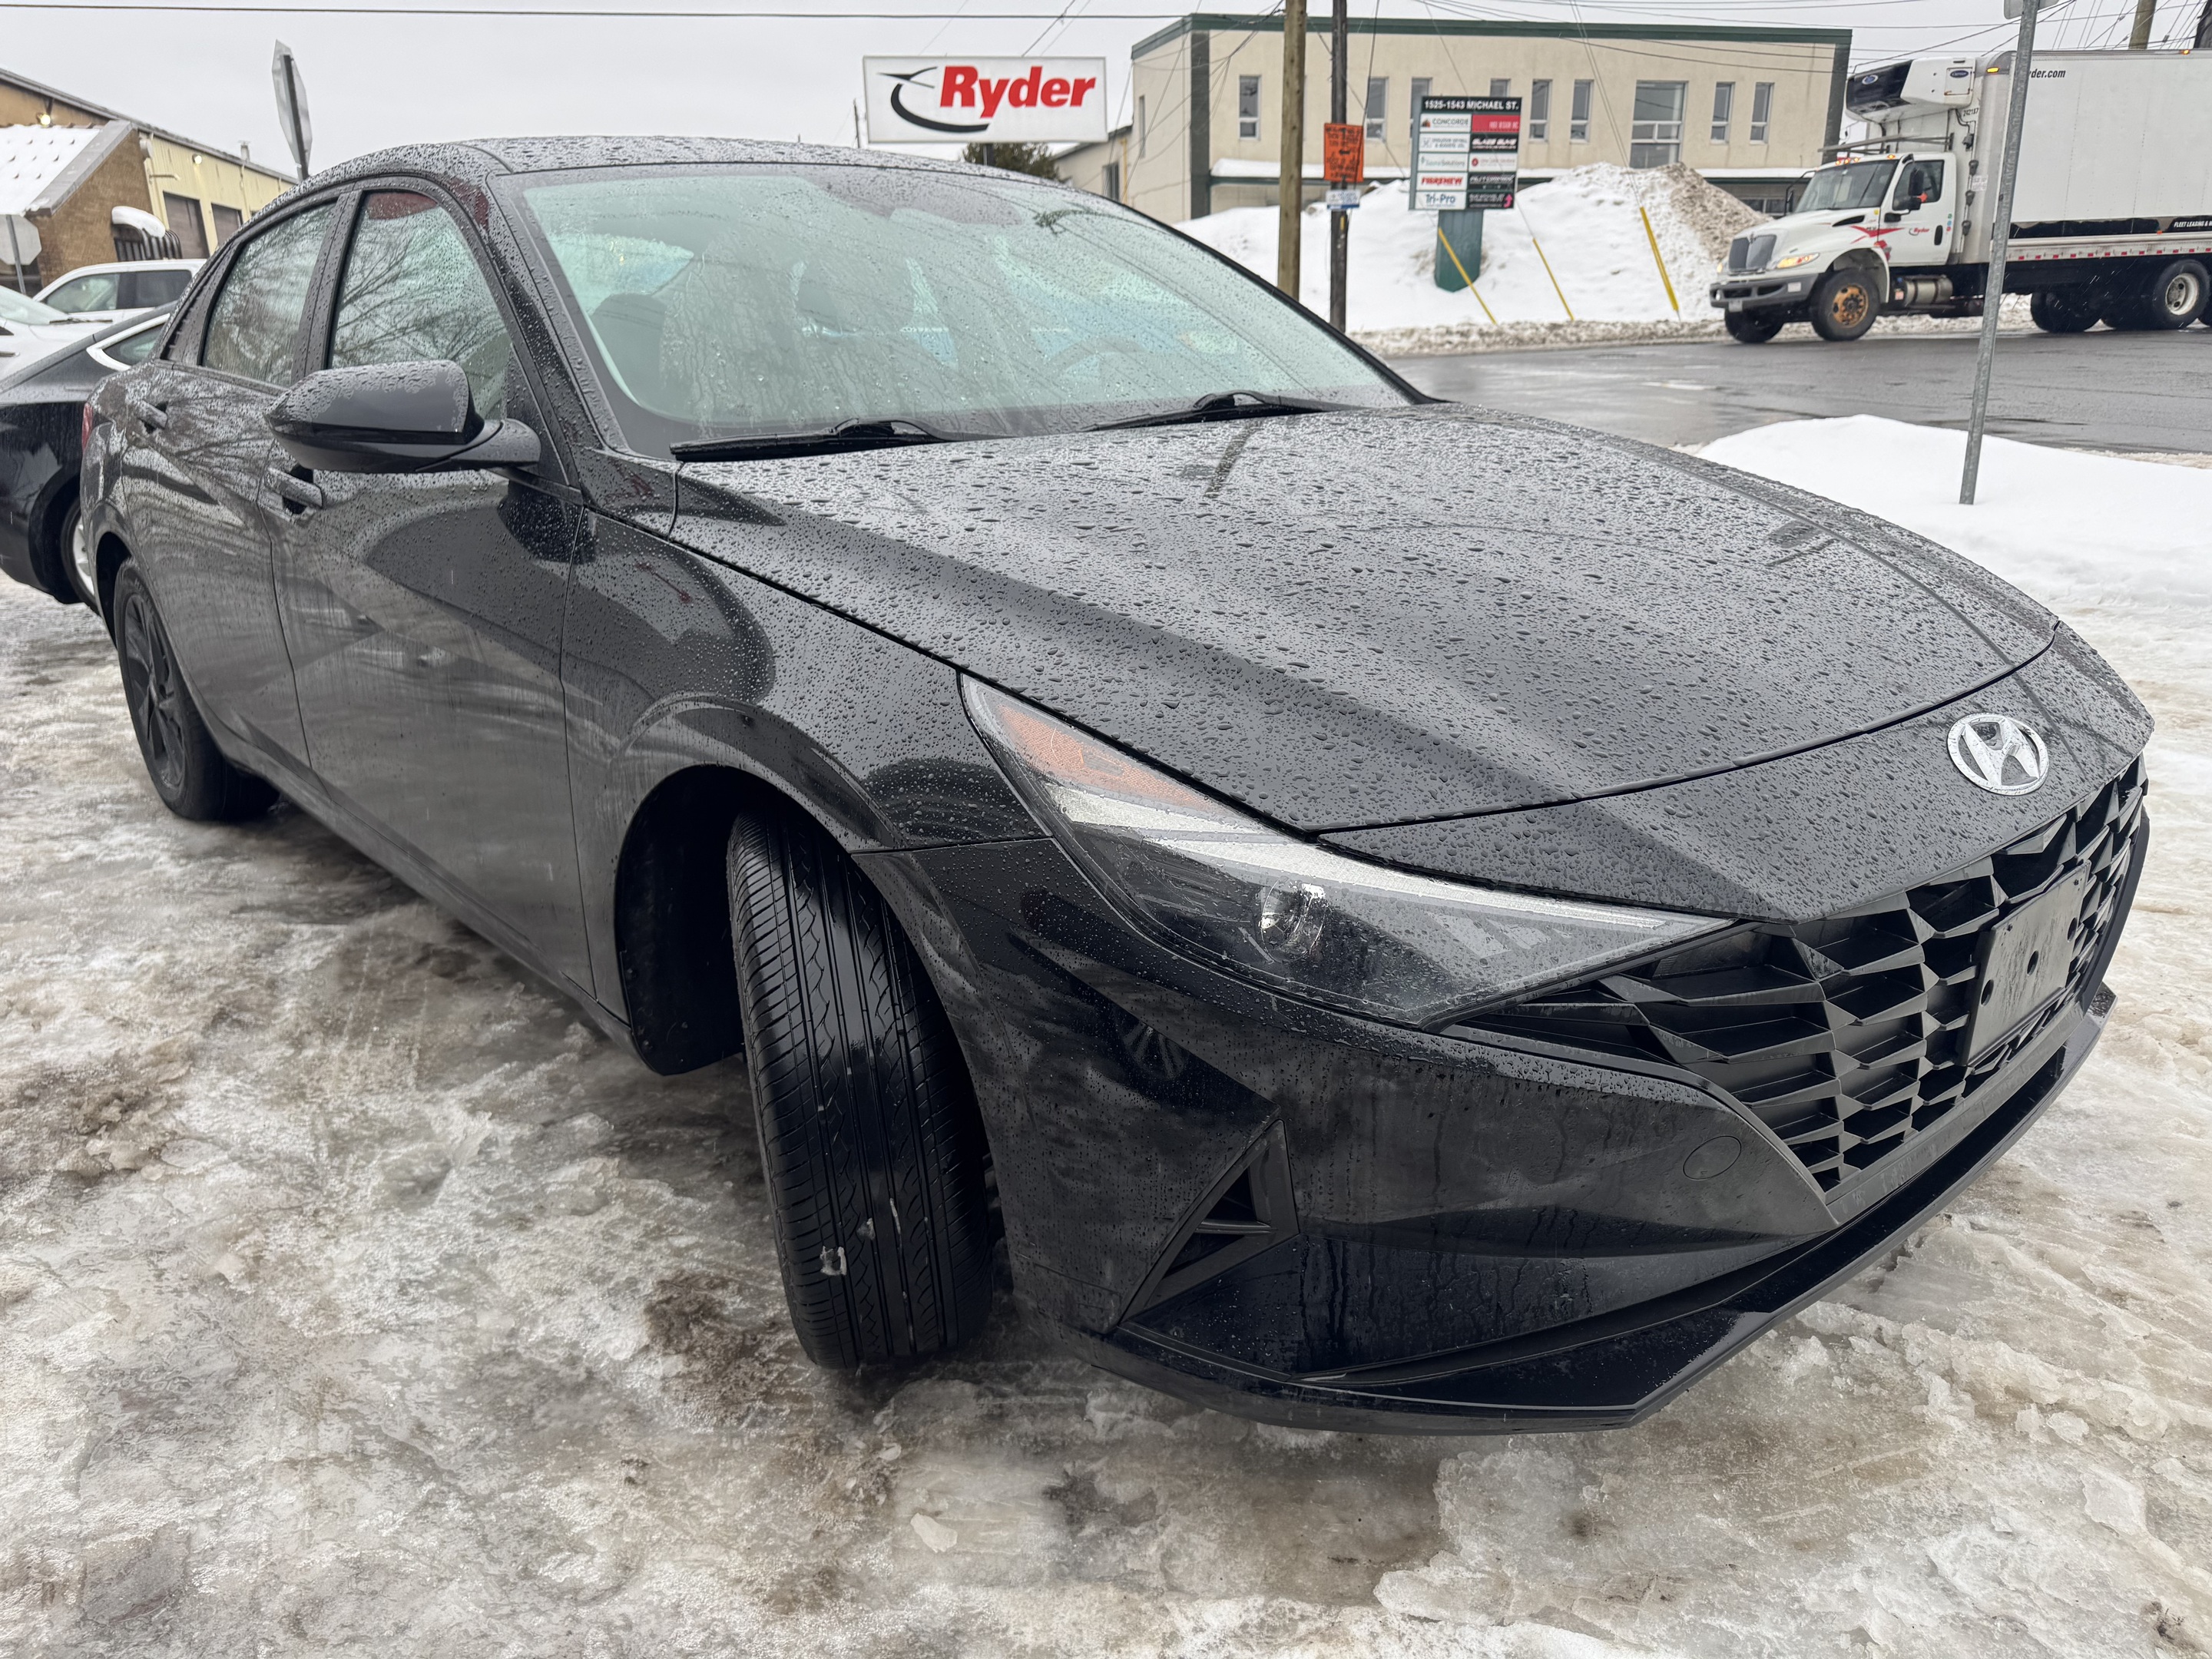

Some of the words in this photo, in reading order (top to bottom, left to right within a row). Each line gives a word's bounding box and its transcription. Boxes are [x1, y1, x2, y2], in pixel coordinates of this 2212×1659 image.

[2029, 68, 2066, 78] der.com
[939, 65, 1097, 119] Ryder
[1424, 99, 1465, 110] 1525-1543
[1466, 100, 1504, 111] MICHAEL
[1505, 101, 1519, 111] ST.
[1426, 193, 1456, 204] Tri-Pro
